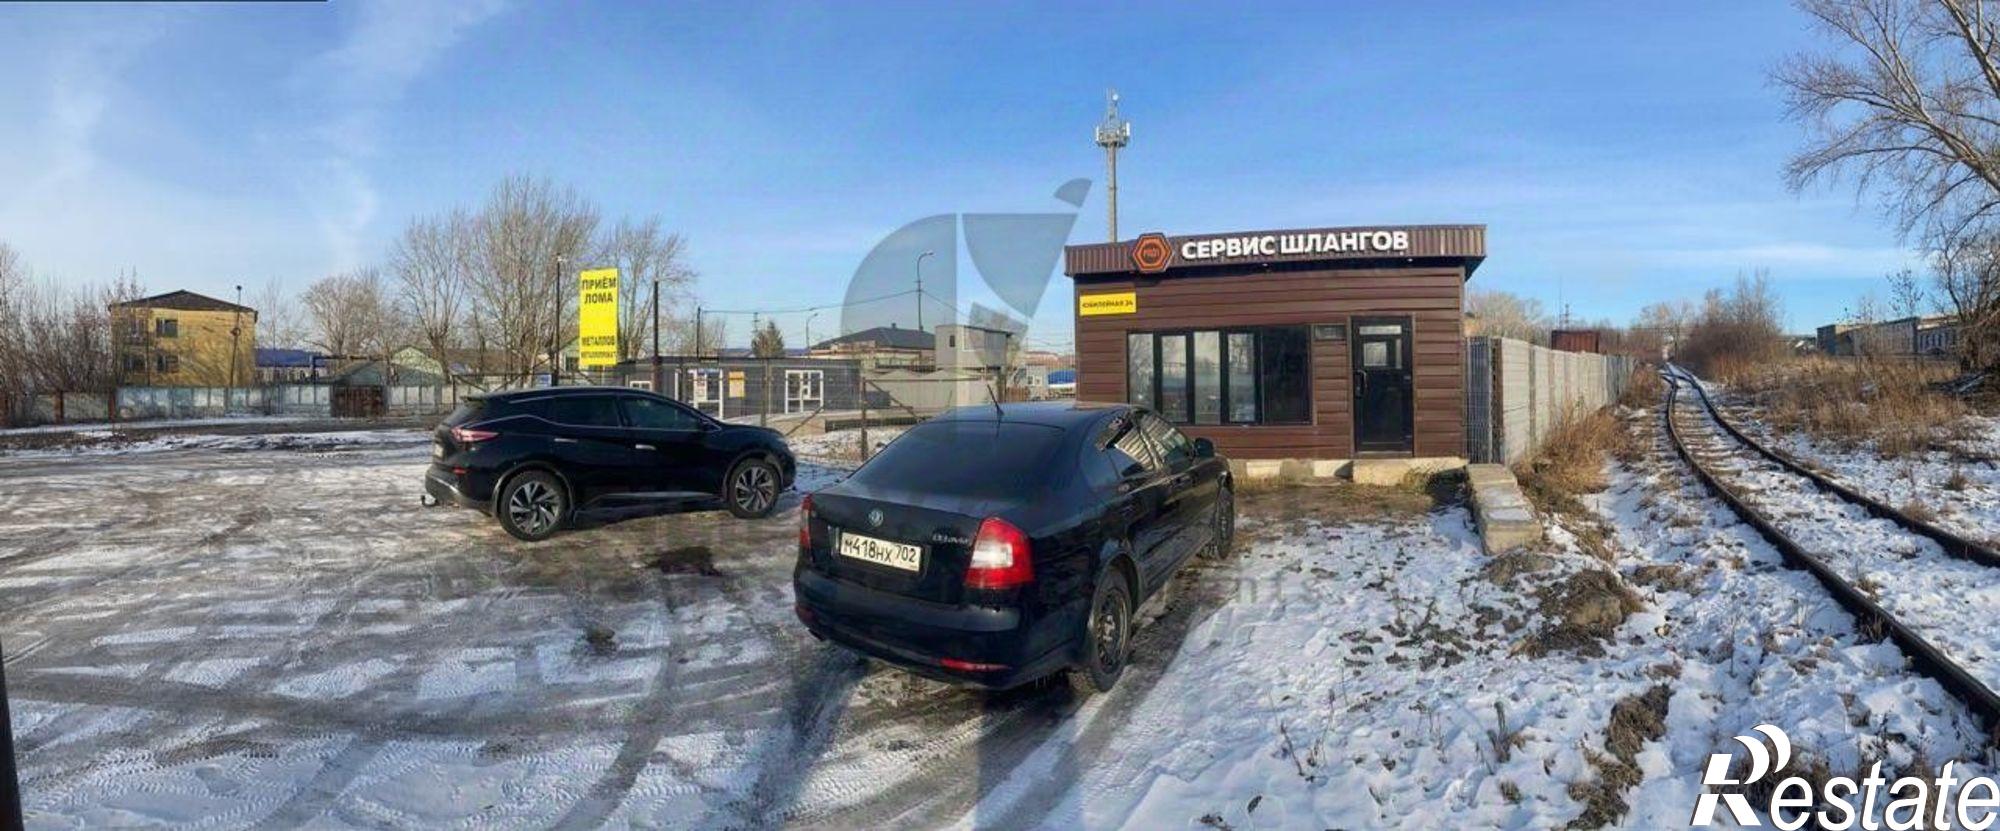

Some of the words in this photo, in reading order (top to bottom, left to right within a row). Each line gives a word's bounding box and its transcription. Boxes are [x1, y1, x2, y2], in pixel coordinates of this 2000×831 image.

[1181, 236, 1277, 260] СЕРВИС
[1280, 231, 1409, 255] ШЛАНГОВ
[582, 276, 616, 290] ПРИЁМ
[584, 292, 614, 304] ЛОМА
[581, 335, 615, 346] МЕТАЛЛОВ
